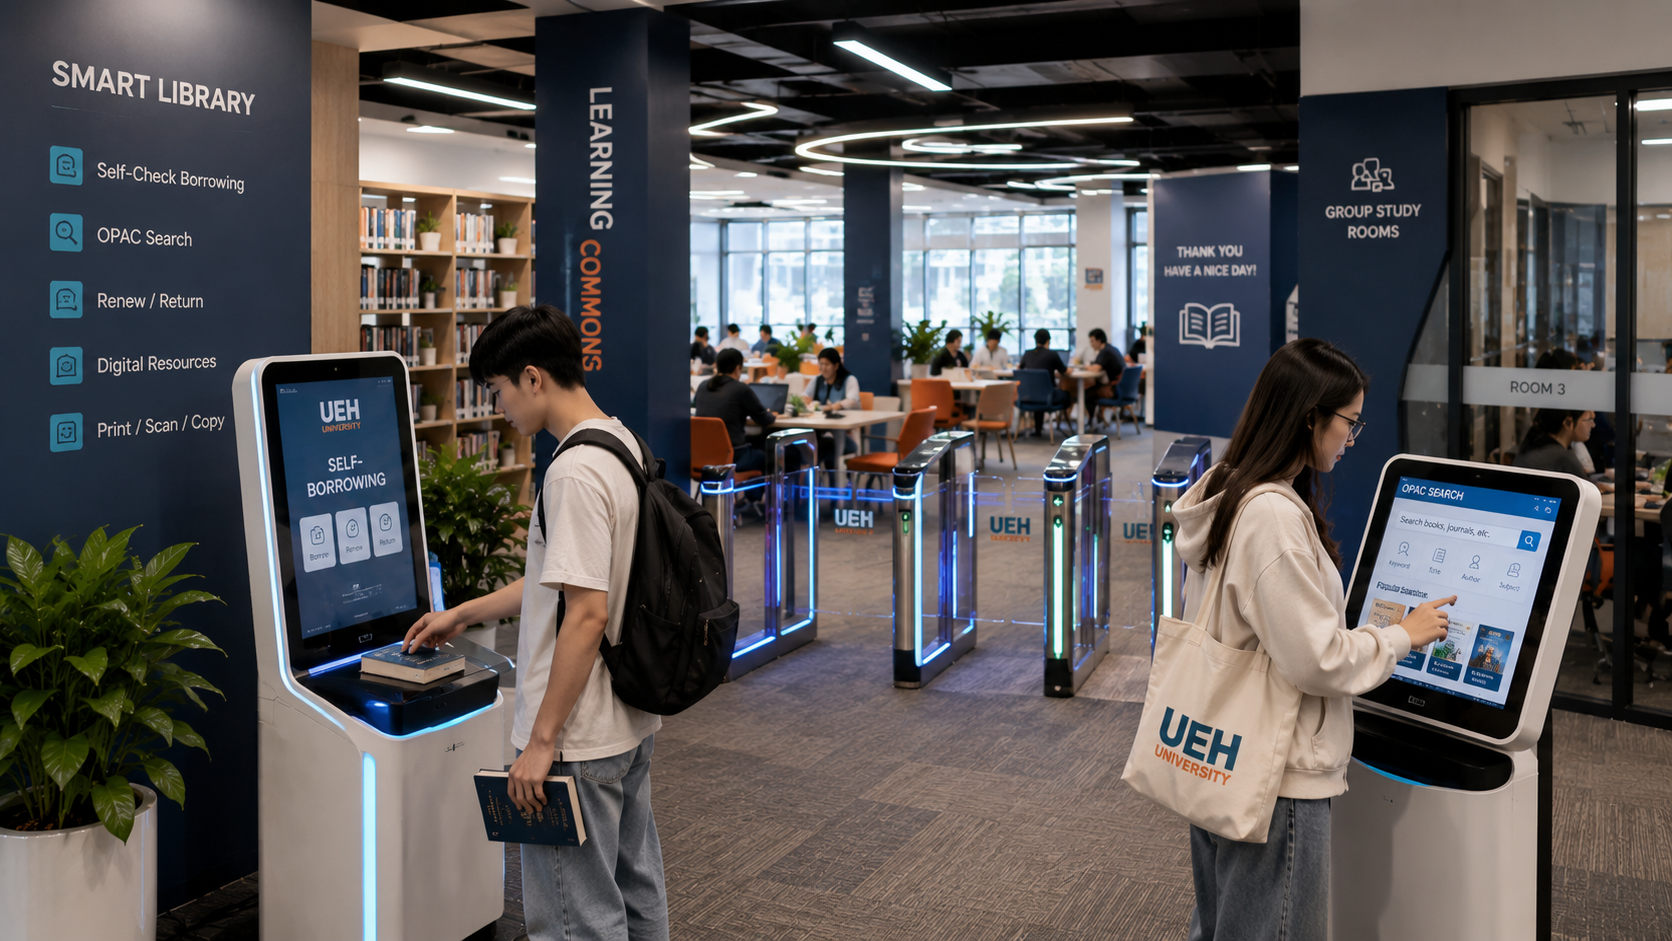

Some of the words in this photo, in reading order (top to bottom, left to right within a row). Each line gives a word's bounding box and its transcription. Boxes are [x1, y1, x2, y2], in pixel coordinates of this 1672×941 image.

[52, 60, 150, 99] SMART
[158, 78, 256, 116] LIBRARY
[589, 87, 613, 230] LEARNING
[97, 162, 177, 186] Self-Check
[181, 170, 245, 194] Borrowing
[1325, 205, 1373, 219] GROUP
[1376, 204, 1422, 217] STUDY
[97, 227, 142, 245] OPAC
[146, 229, 193, 247] Search
[1348, 225, 1400, 239] ROOMS
[1177, 246, 1216, 258] THANK
[1218, 245, 1243, 257] YOU
[1164, 265, 1191, 277] HAVE
[1193, 265, 1202, 276] A
[1204, 265, 1229, 277] NICE
[1231, 264, 1257, 277] DAY!
[97, 292, 146, 310] Renew
[149, 292, 156, 310] /
[160, 293, 204, 309] Return
[580, 239, 602, 372] COMMONS
[97, 355, 144, 377] Digital
[148, 354, 217, 372] Resources
[1510, 381, 1553, 395] ROOM
[1557, 383, 1566, 395] 3
[319, 399, 361, 423] UEH
[97, 420, 132, 438] Print
[135, 419, 142, 437] /
[145, 417, 178, 435] Scan
[181, 415, 188, 433] /
[191, 413, 225, 432] Copy
[322, 422, 361, 433] UNIVERSITY
[328, 455, 363, 472] SELF-
[307, 472, 386, 497] BORROWING
[1402, 483, 1427, 496] OPAC
[1428, 487, 1464, 501] SEARCH
[834, 509, 874, 528] UEH
[990, 516, 1030, 535] UEH
[1400, 515, 1423, 527] Search
[1424, 518, 1445, 531] books,
[1447, 522, 1475, 537] journals,
[1159, 706, 1243, 772] UEH
[1154, 743, 1232, 786] UNIVERSITY
